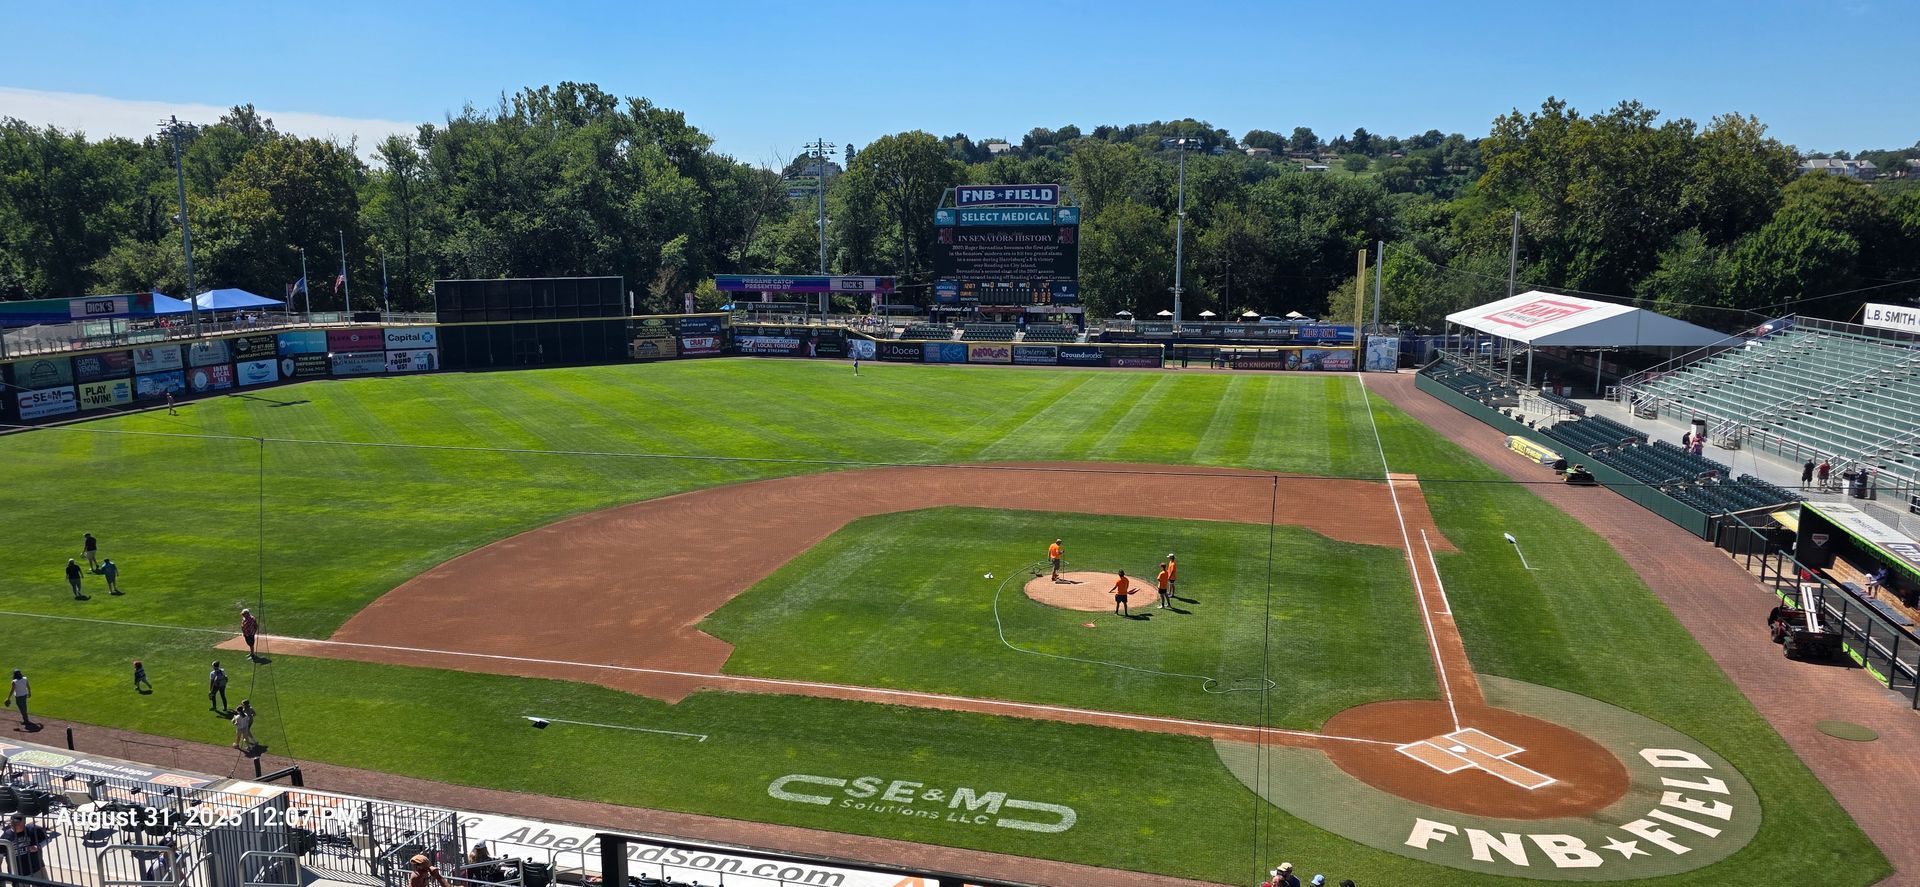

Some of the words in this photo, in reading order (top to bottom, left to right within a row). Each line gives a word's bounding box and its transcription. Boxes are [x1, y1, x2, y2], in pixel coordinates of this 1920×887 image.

[962, 190, 995, 202] FNB
[1005, 189, 1053, 201] FIELD
[962, 213, 999, 221] SELECT
[1001, 212, 1049, 221] MEDICAL
[843, 281, 863, 289] DICK'S
[87, 301, 113, 314] DICK'S
[1866, 309, 1883, 321] L.B.
[1885, 311, 1916, 326] SMITH
[387, 333, 420, 343] Capital
[1302, 328, 1318, 338] KIDS
[1320, 328, 1337, 338] ZONE
[742, 338, 755, 348] 27
[892, 346, 919, 355] Doceo
[1060, 351, 1102, 359] Groundworks
[77, 357, 99, 366] CAPITAL
[390, 357, 411, 365] FOUND
[33, 390, 60, 402] SE&M
[85, 385, 107, 396] PLAY
[91, 393, 112, 405] WIN!
[76, 758, 113, 770] Eastern
[115, 764, 152, 777] League
[844, 776, 1007, 815] SE&M
[839, 799, 939, 819] Solutions
[946, 811, 990, 825] LLC
[1404, 818, 1604, 868] FNB
[1619, 748, 1734, 854] FIELD
